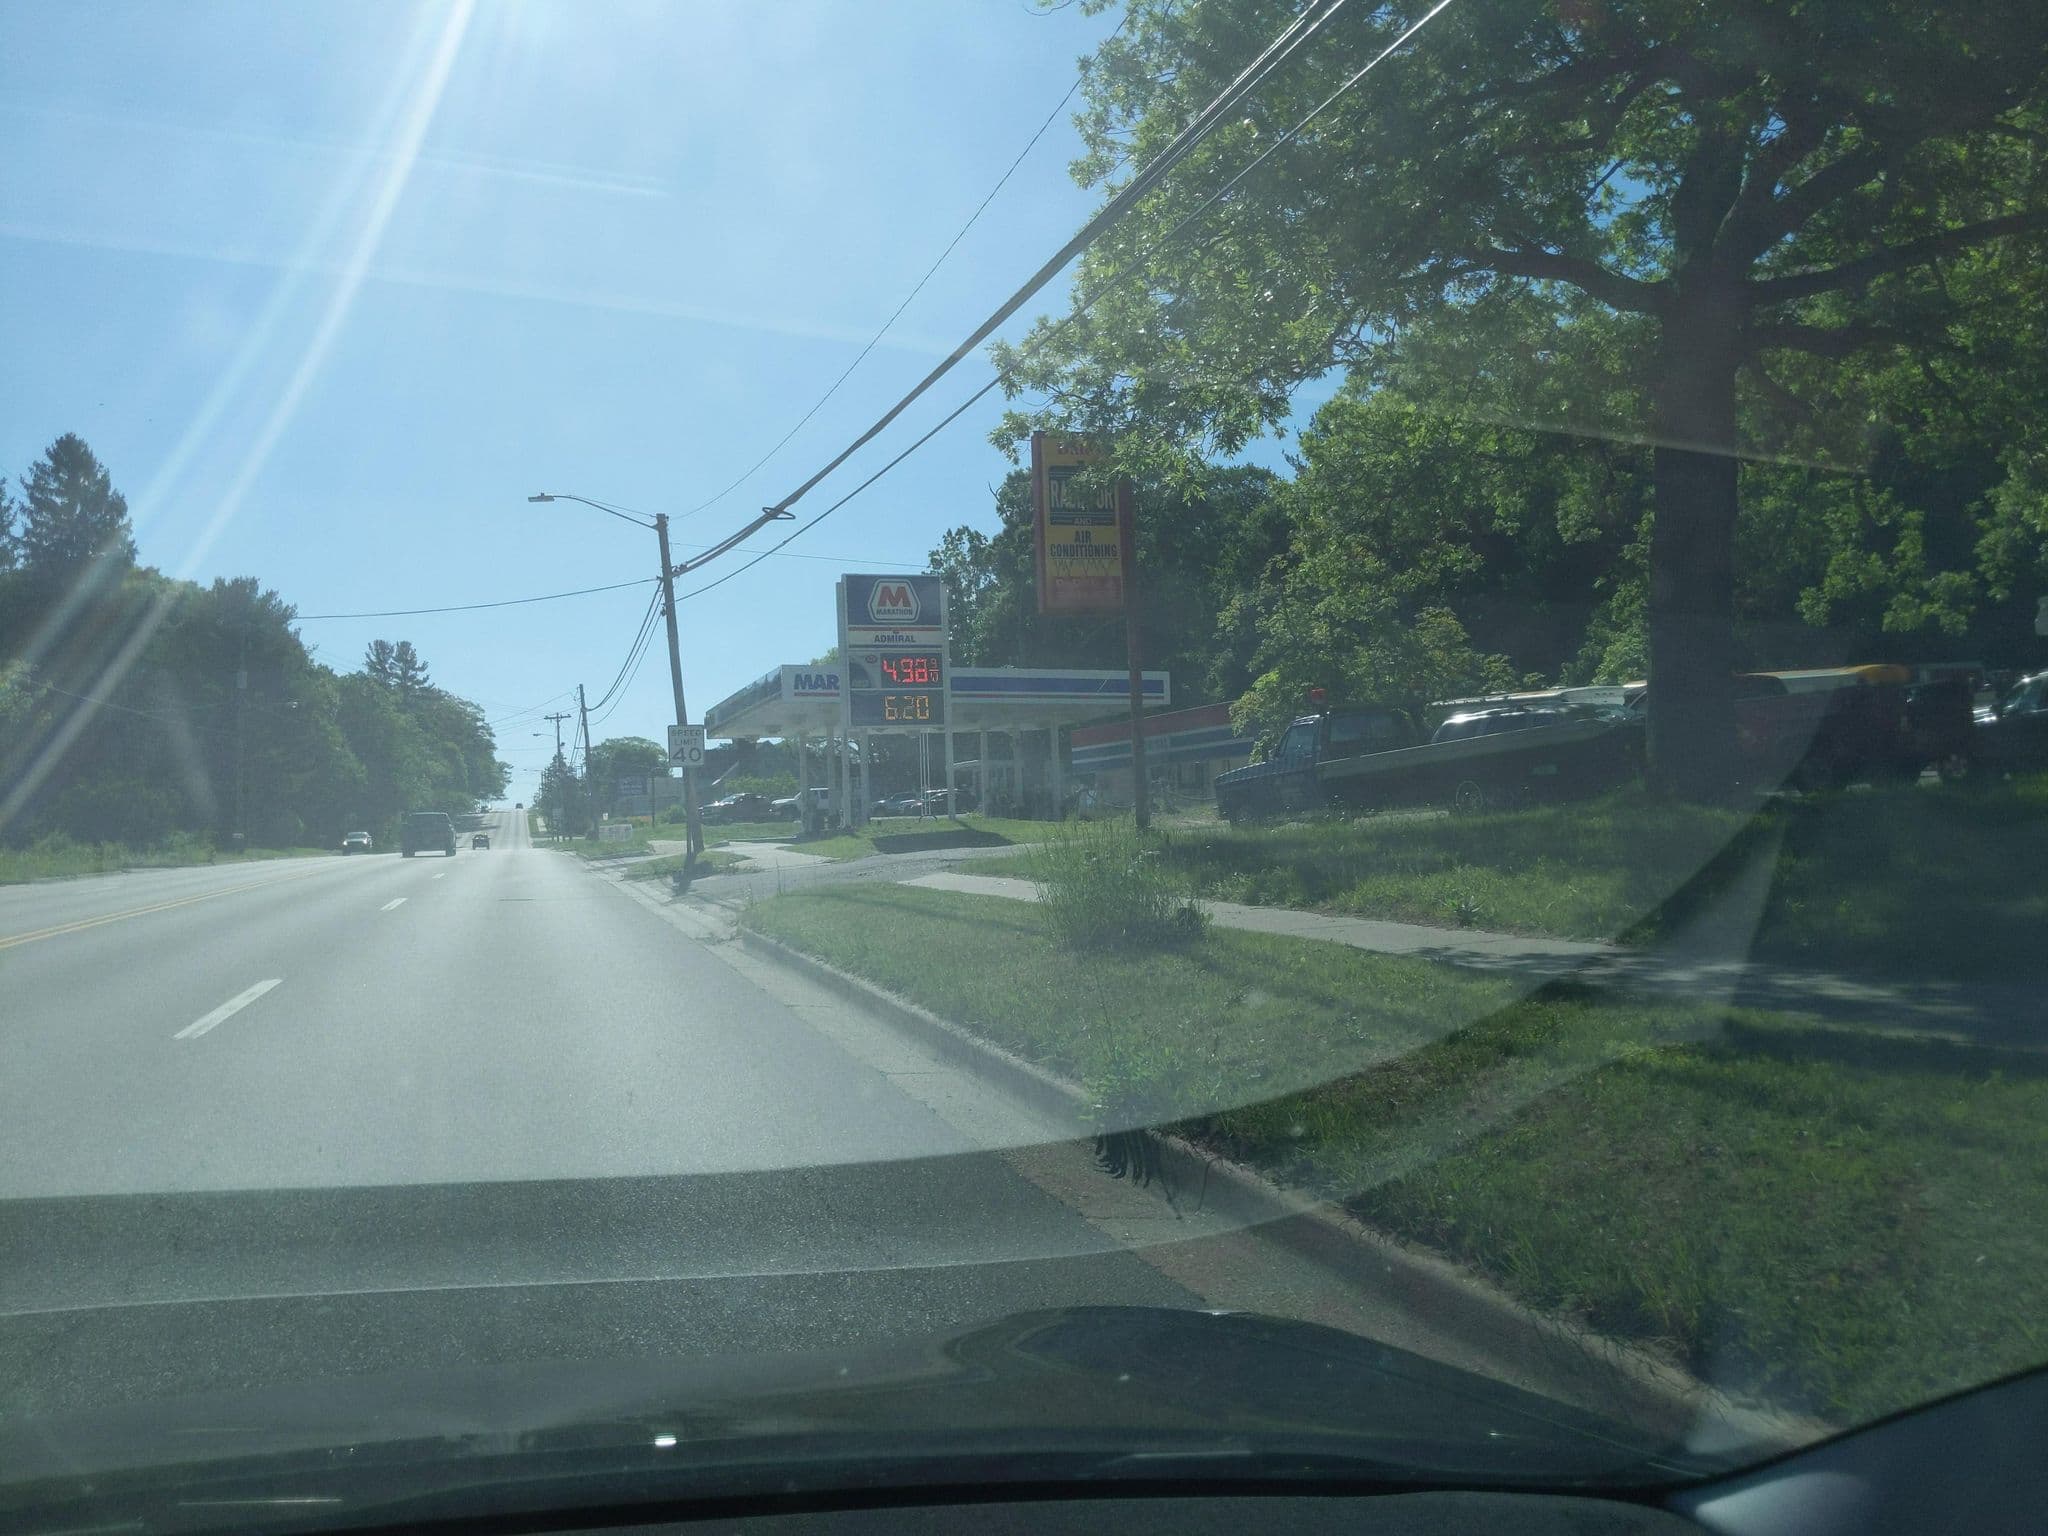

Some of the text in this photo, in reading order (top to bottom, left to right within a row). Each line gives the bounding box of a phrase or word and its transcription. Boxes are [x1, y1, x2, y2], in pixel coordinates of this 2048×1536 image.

[1074, 530, 1092, 544] AIR
[1050, 544, 1117, 557] CONDITIONING
[878, 586, 912, 607] M
[876, 608, 913, 617] MARATHON
[874, 634, 916, 643] ADMIRAL
[794, 673, 840, 690] MAR
[671, 729, 702, 737] SPEED
[674, 738, 699, 746] LIMIT
[671, 747, 702, 762] 40
